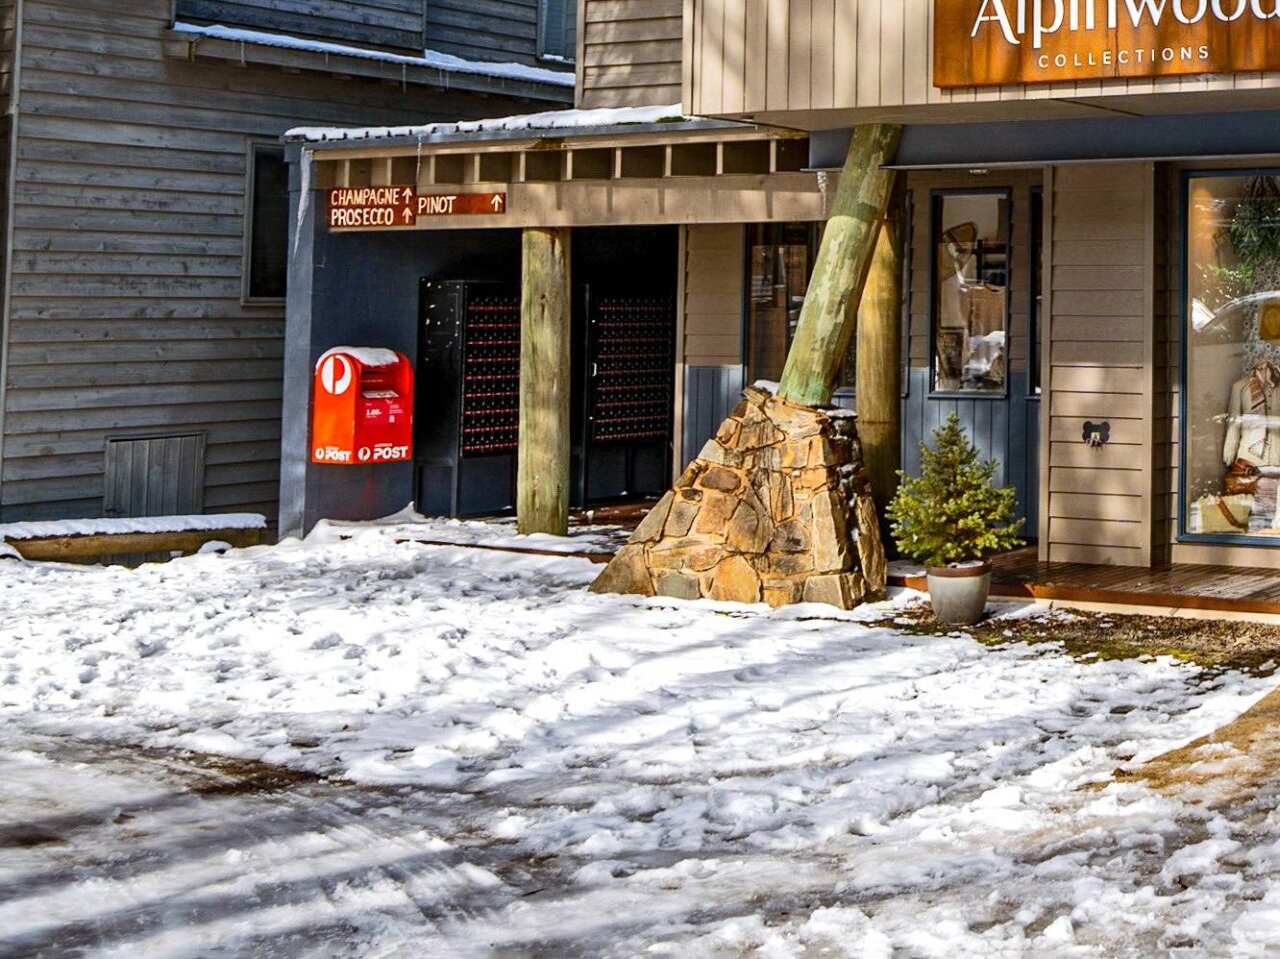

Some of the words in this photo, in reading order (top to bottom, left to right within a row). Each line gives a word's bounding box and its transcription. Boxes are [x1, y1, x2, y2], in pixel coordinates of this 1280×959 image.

[1038, 45, 1209, 69] COLLECTIONS
[330, 188, 400, 206] CHAMPAGNE
[417, 196, 457, 214] PINOT
[330, 207, 394, 226] PROSECCO
[325, 449, 352, 461] POST
[373, 446, 409, 460] POST
